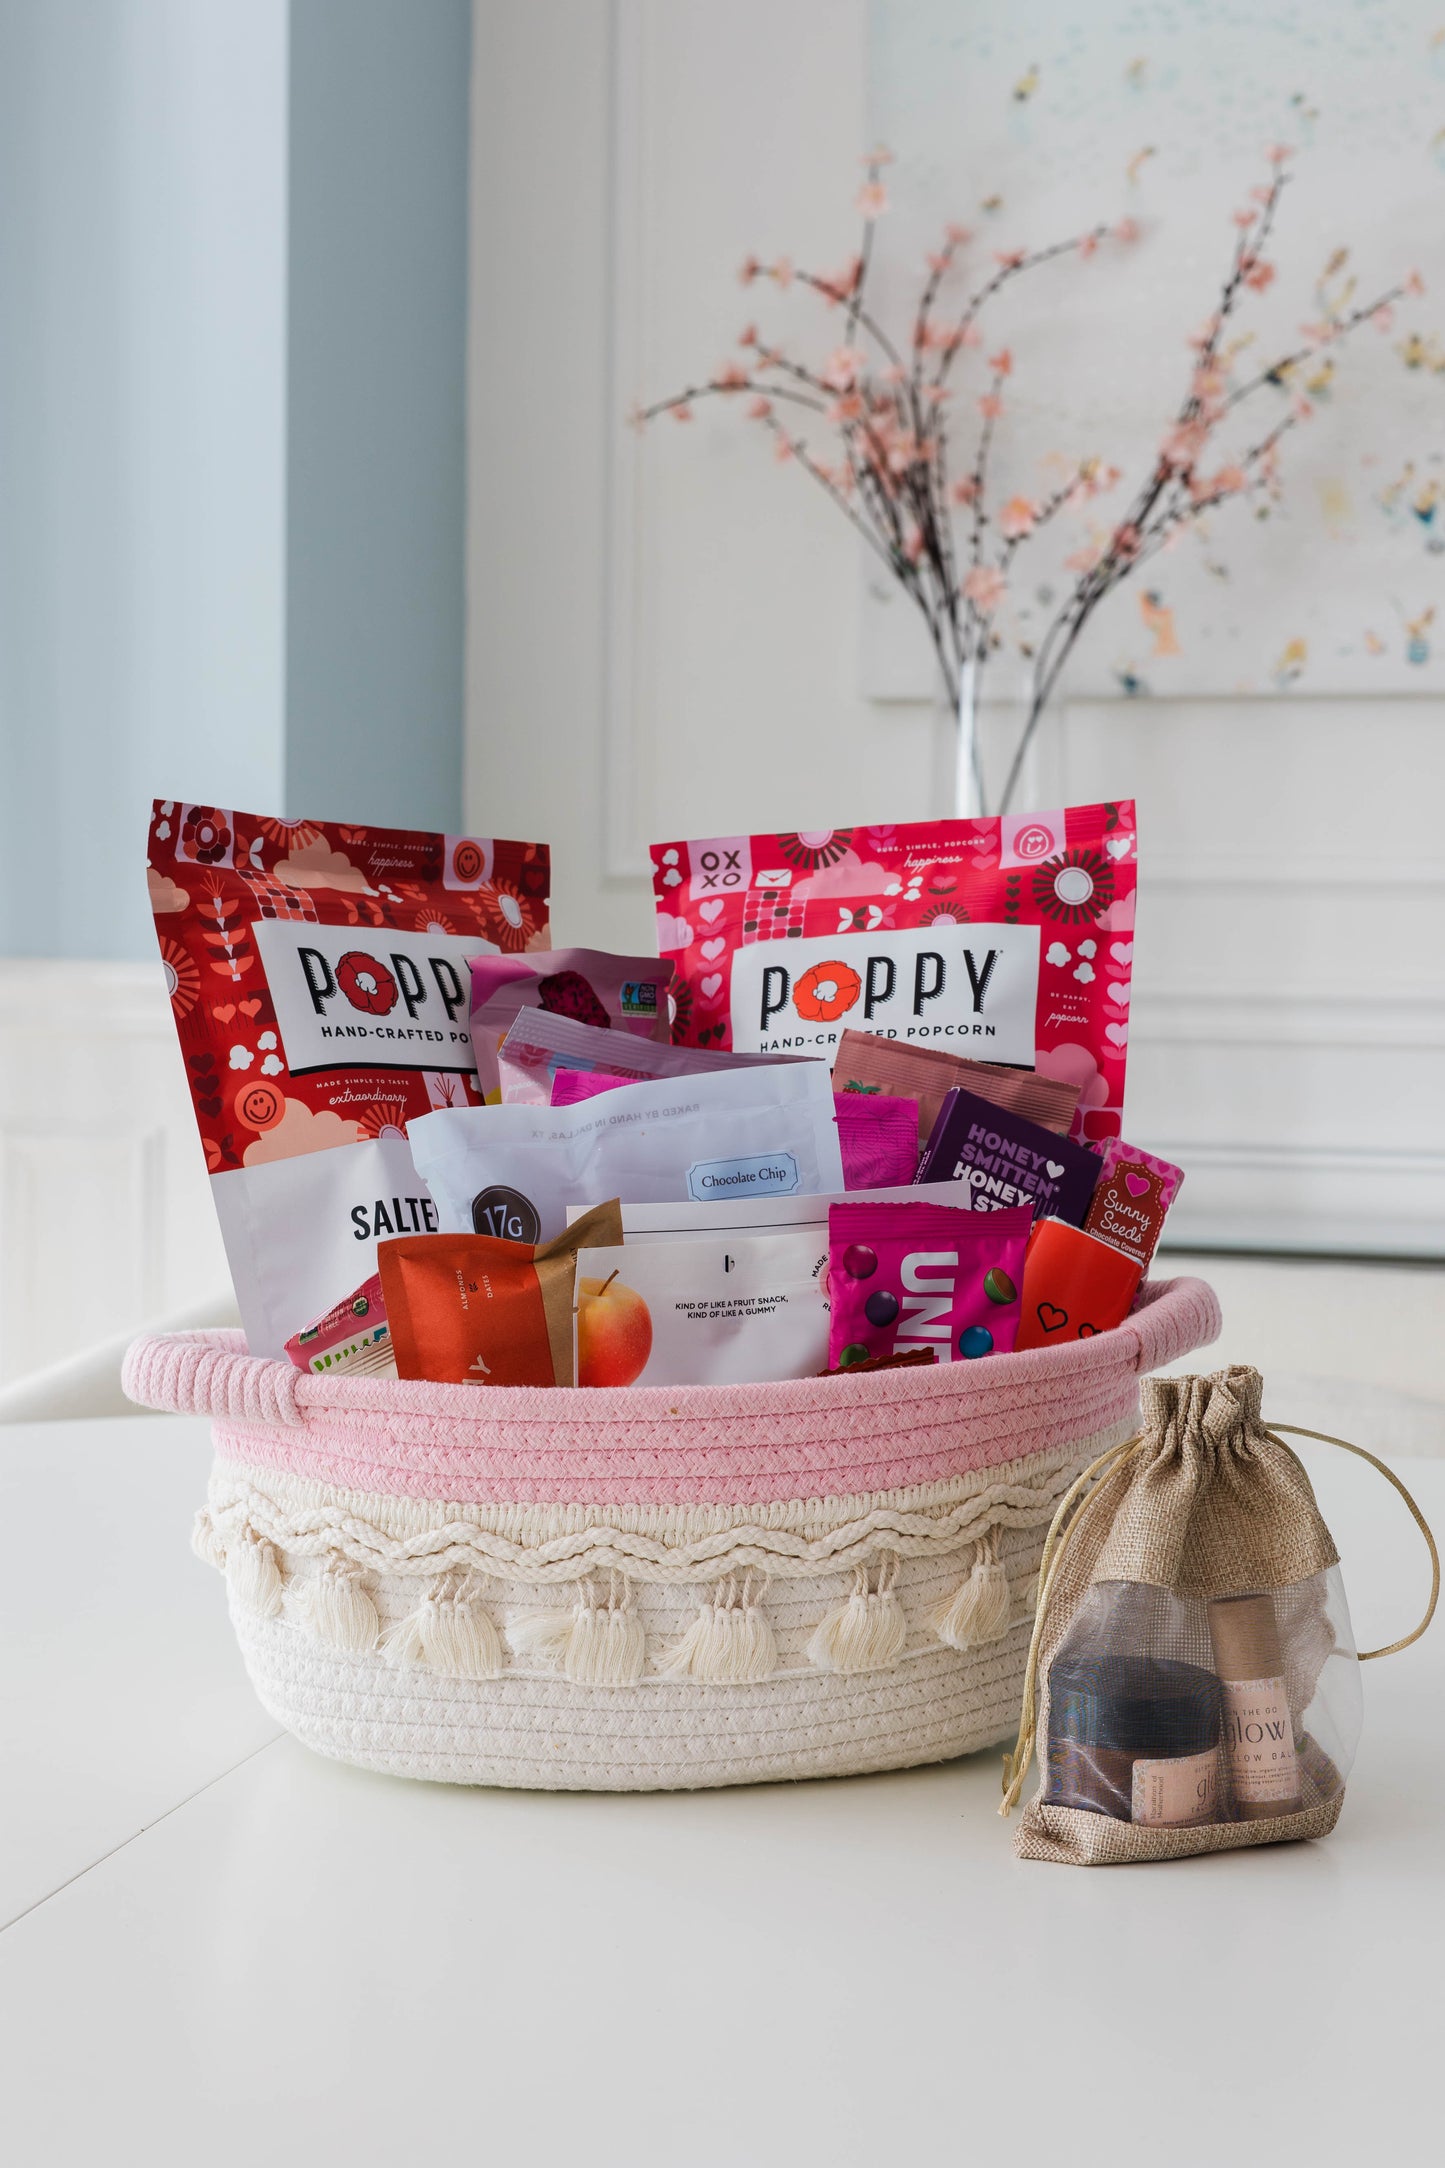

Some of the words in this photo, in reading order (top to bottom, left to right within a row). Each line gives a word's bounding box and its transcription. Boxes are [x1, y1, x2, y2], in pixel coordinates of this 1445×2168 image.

[944, 839, 985, 847] POPCORN
[368, 850, 415, 876] happiness
[903, 852, 963, 875] happiness
[297, 947, 473, 1023] POPP
[907, 1024, 996, 1037] POPCORN
[1044, 1012, 1089, 1029] popcorn
[321, 1026, 444, 1042] HAND-CRAFTED
[316, 1080, 341, 1088] MADE
[329, 1087, 408, 1112] extraordinary
[967, 1123, 1047, 1171] HONEY
[702, 1172, 756, 1188] Chocolate
[758, 1166, 786, 1181] Chip
[952, 1161, 1034, 1206] HONEY
[351, 1197, 439, 1240] SALTE
[1103, 1189, 1151, 1231] Sunny
[1100, 1210, 1142, 1243] Seeds
[1090, 1227, 1120, 1247] Chocolate
[1120, 1242, 1146, 1258] Covered
[811, 1254, 828, 1278] MADE
[456, 1270, 469, 1310] ALMONDS
[482, 1274, 493, 1298] DATES
[675, 1302, 695, 1310] KIND
[733, 1298, 756, 1307] FRUIT
[758, 1295, 789, 1305] SNACK,
[687, 1311, 707, 1319] KIND
[721, 1309, 736, 1317] LIKE
[745, 1306, 776, 1316] GUMMY
